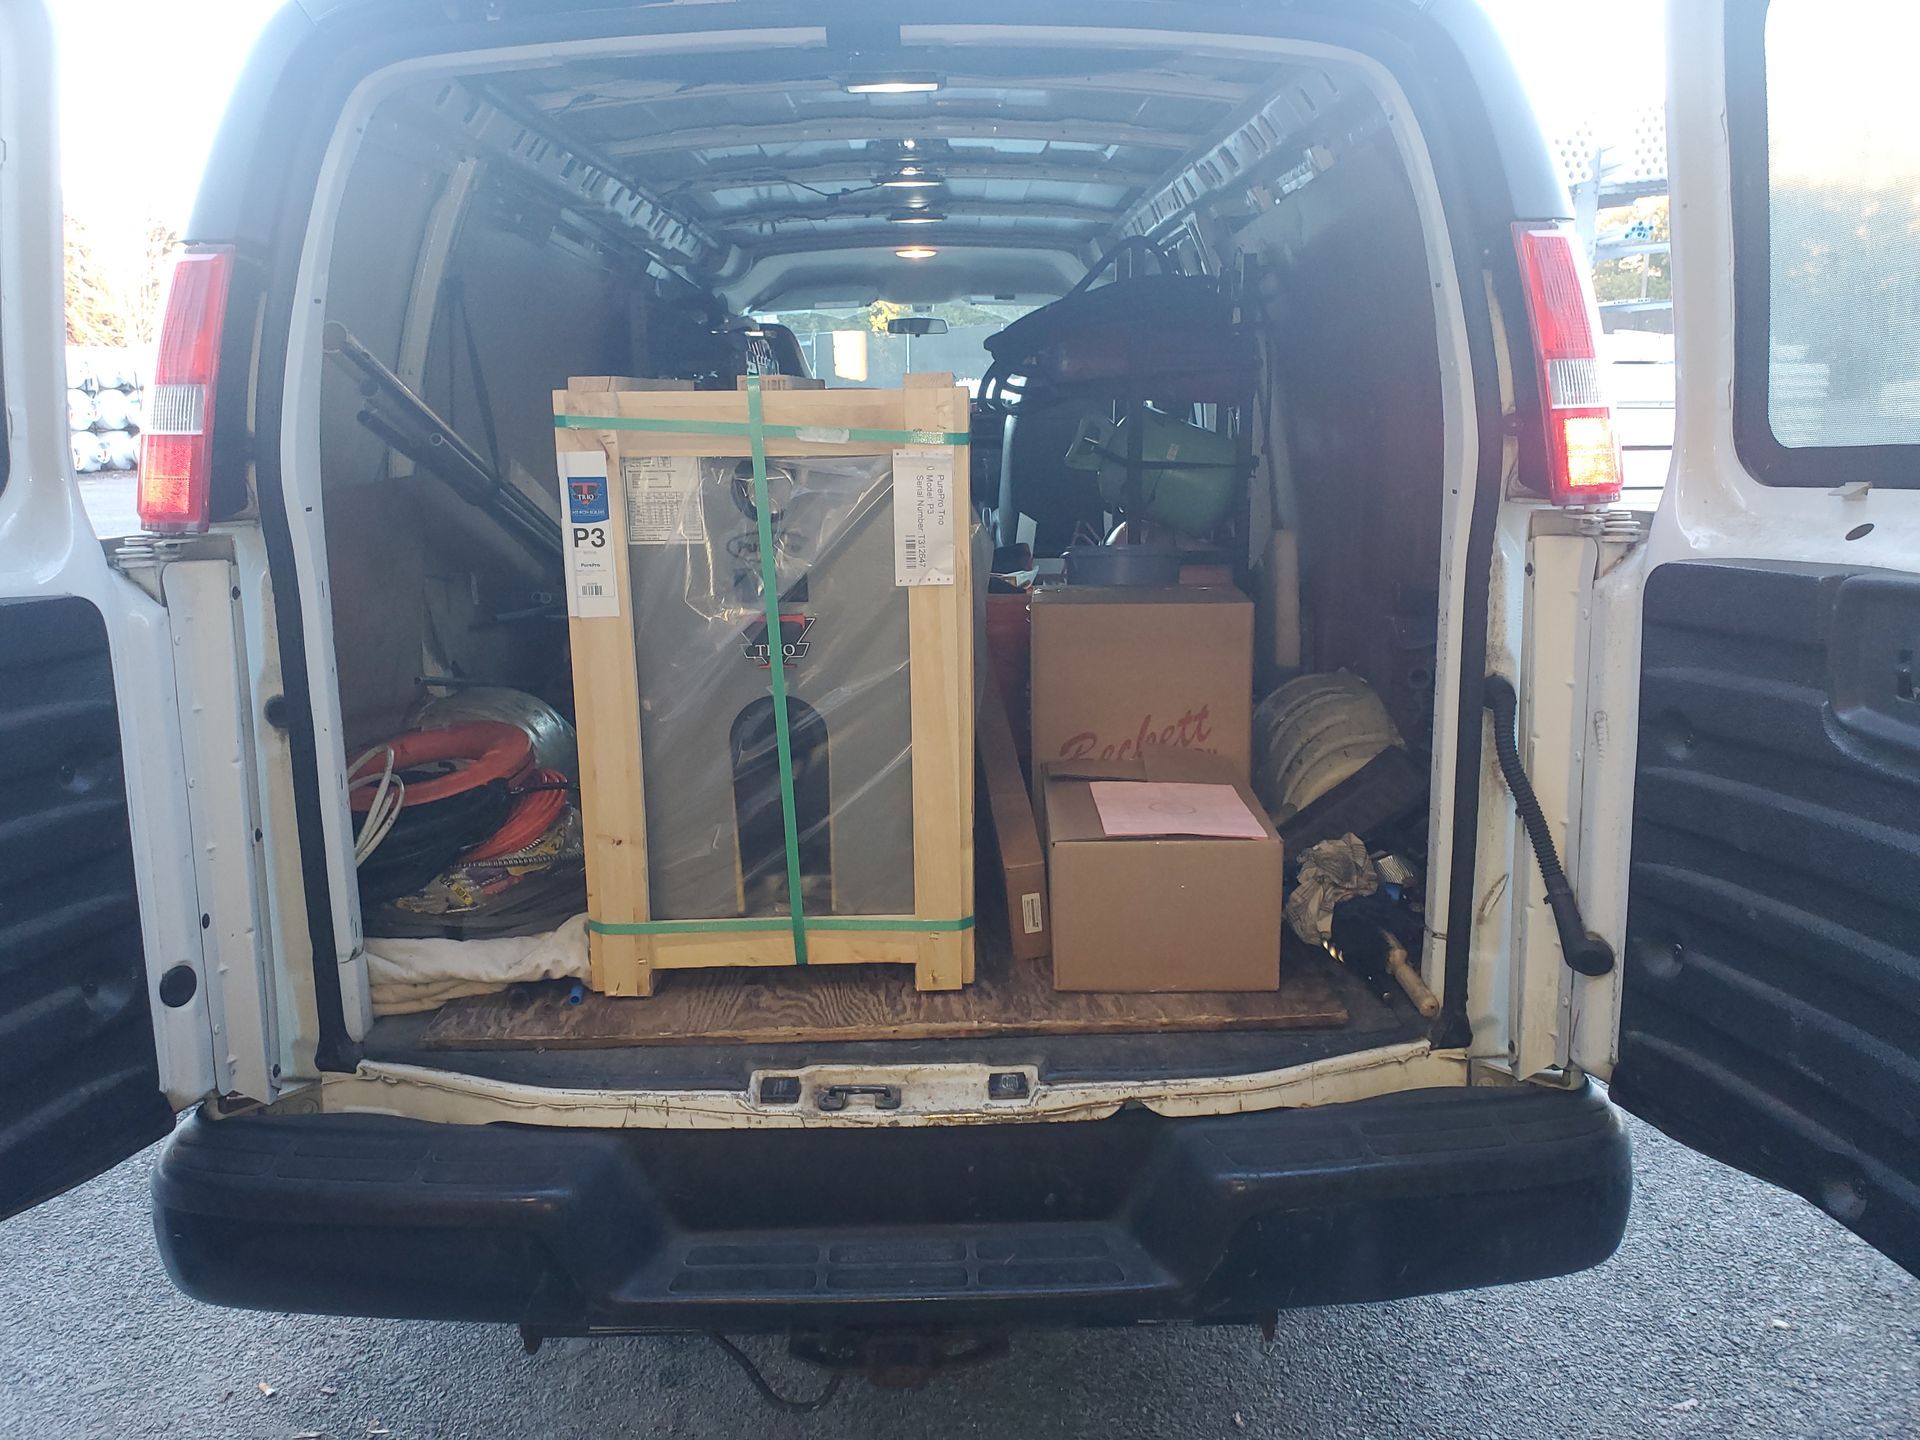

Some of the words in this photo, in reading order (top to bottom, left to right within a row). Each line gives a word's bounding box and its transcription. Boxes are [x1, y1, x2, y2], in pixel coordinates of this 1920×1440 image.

[916, 474, 924, 498] Serial
[937, 474, 945, 508] PurePro
[927, 503, 934, 515] P3
[573, 527, 606, 548] P3
[754, 643, 796, 657] TO
